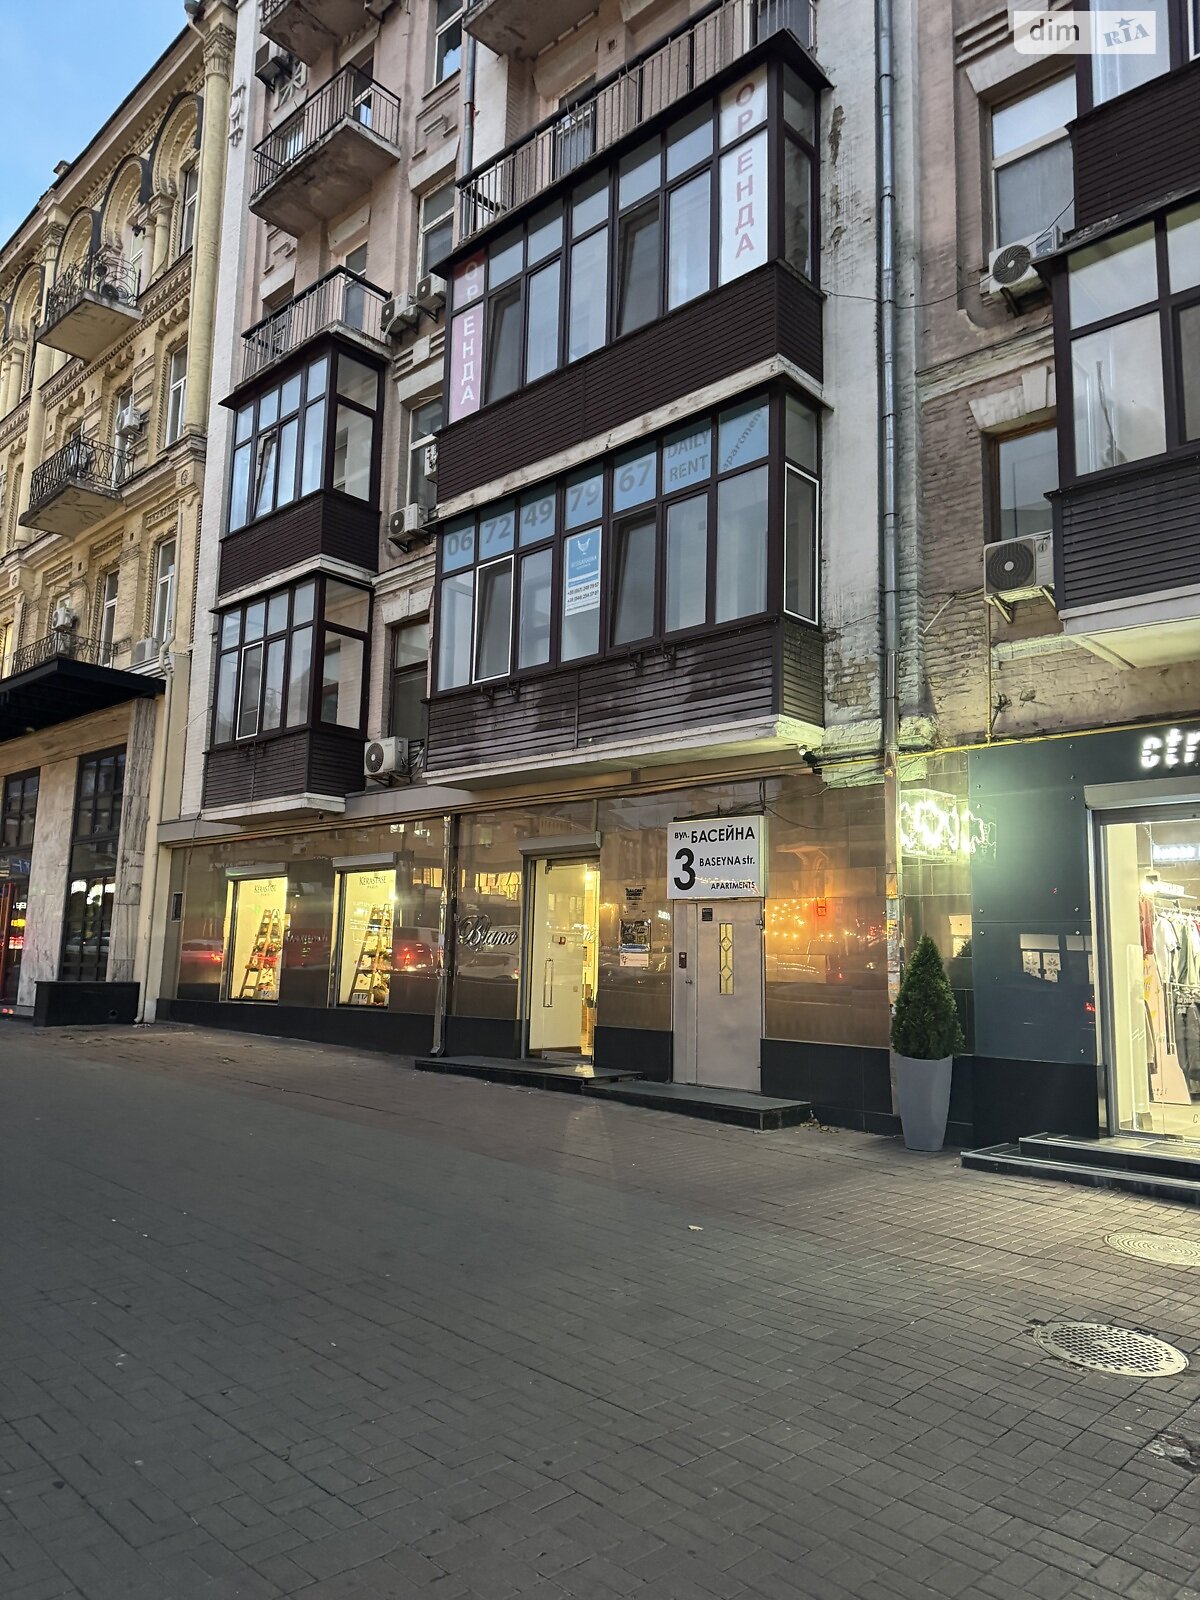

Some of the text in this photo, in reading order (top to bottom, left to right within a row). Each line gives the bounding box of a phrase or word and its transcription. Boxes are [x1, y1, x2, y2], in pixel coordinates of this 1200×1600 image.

[735, 82, 755, 259] ОРЕНДА
[460, 261, 479, 405] ОРЕНДА
[669, 453, 709, 482] RENT
[524, 499, 553, 527] 49
[618, 459, 654, 494] 67
[674, 825, 756, 844] вул. БАСЕЙНА
[673, 847, 696, 891] 3
[699, 854, 756, 867] BASEYNA str.
[710, 881, 756, 890] APARTMENTS
